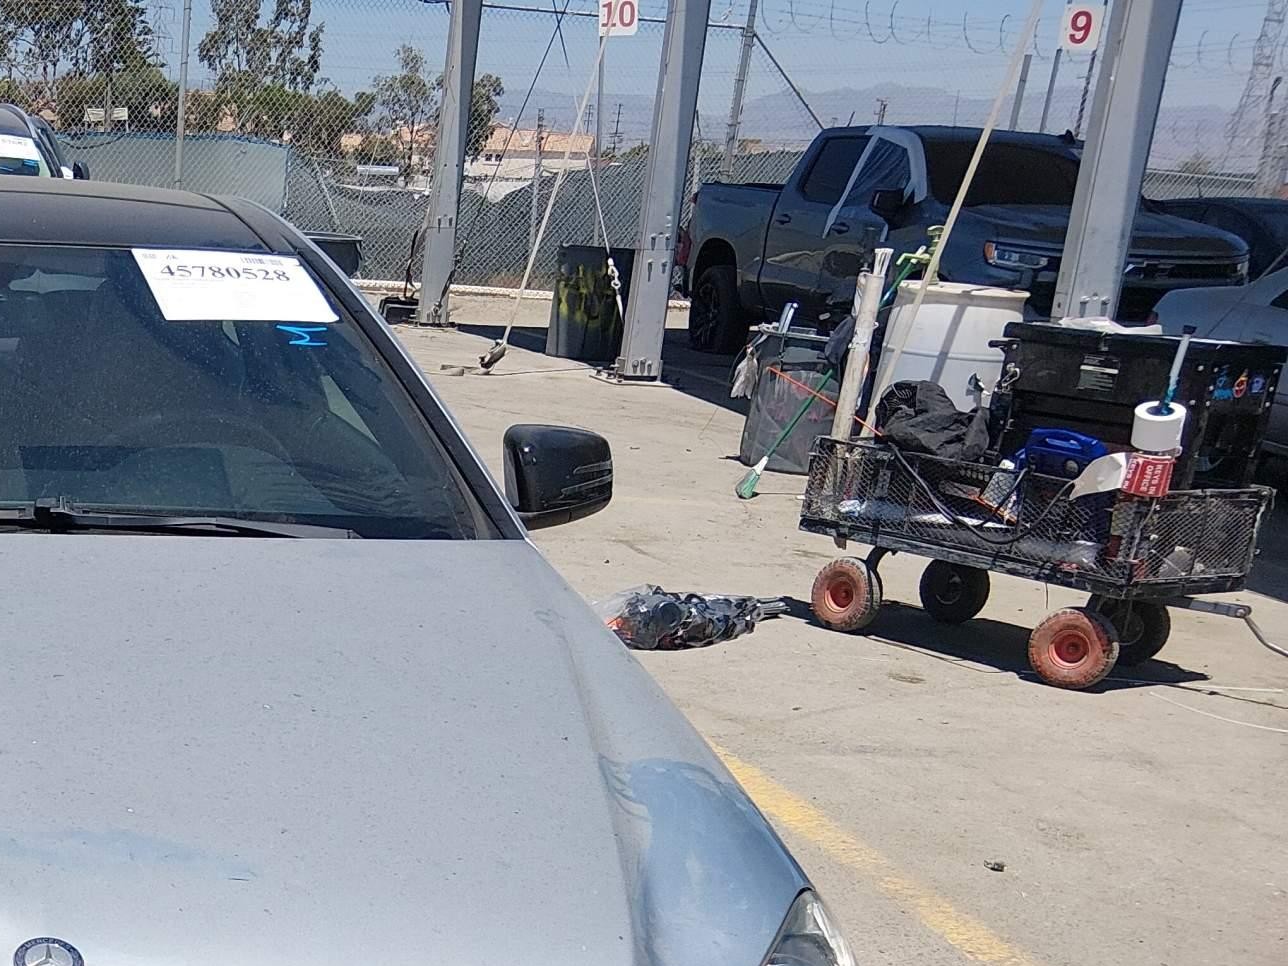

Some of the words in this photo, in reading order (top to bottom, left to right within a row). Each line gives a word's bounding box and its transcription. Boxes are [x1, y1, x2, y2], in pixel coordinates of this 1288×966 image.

[601, 0, 635, 27] 10
[1069, 10, 1092, 44] 9
[160, 264, 290, 282] 45780528
[1139, 465, 1154, 492] OFFICE
[1151, 464, 1163, 485] KEYS
[1148, 486, 1157, 495] IN
